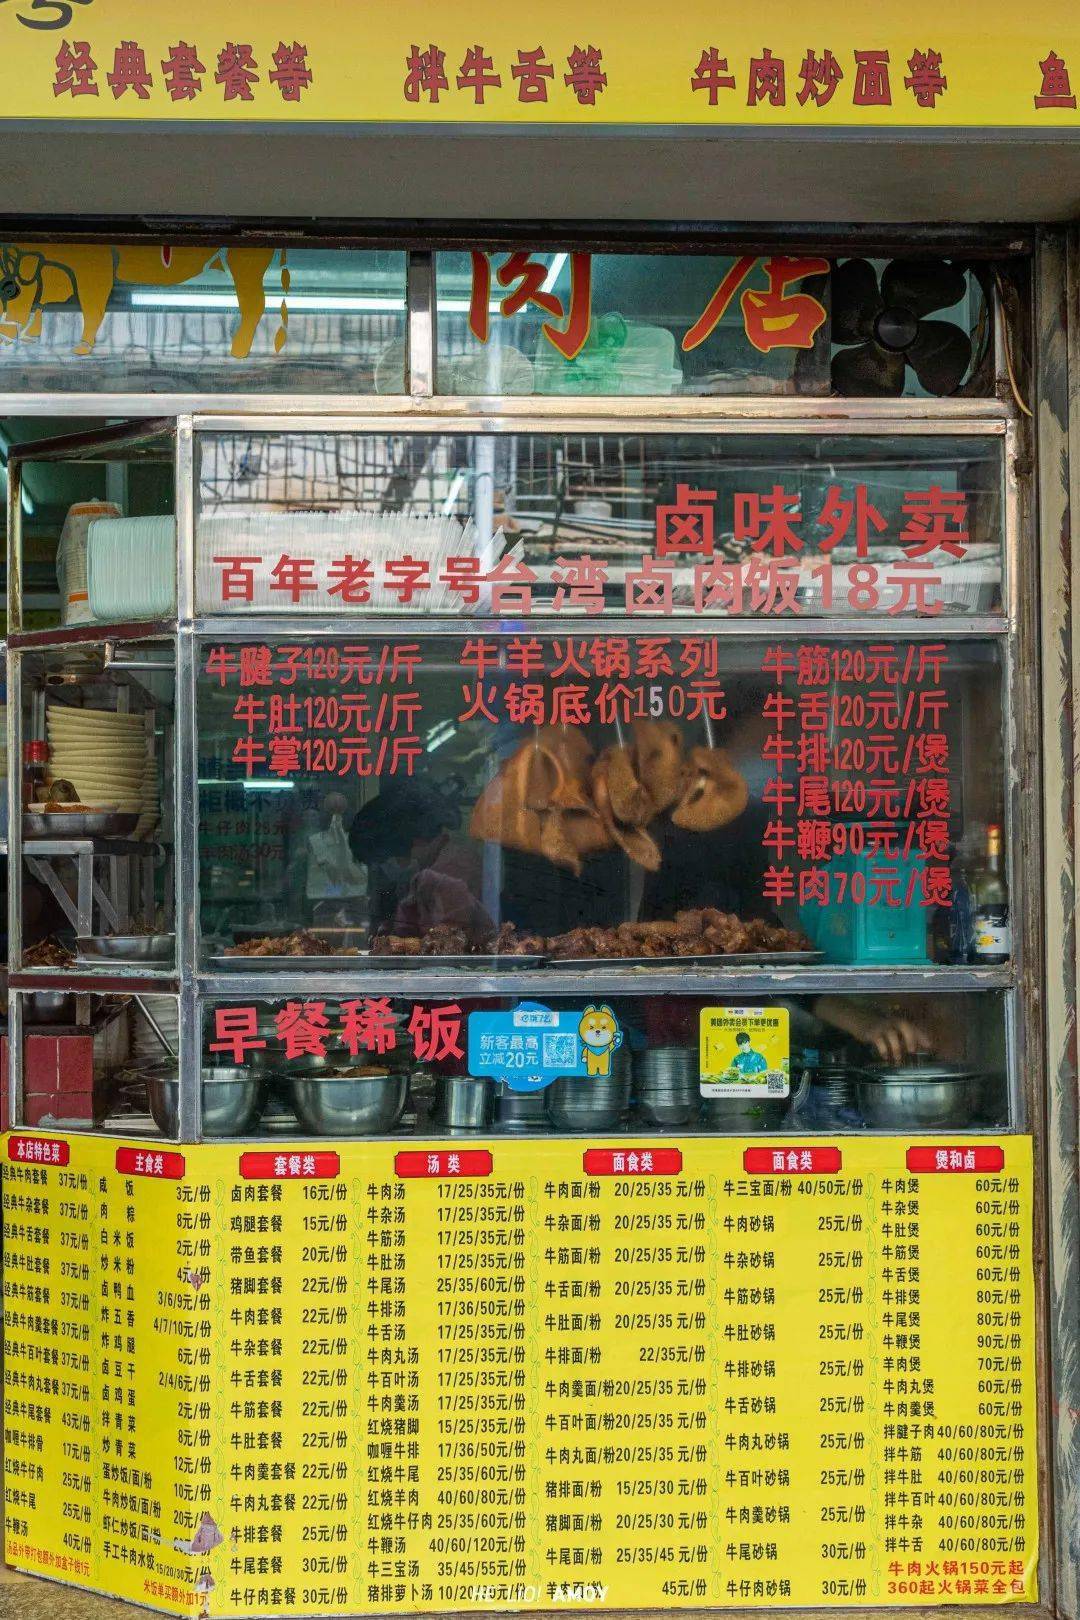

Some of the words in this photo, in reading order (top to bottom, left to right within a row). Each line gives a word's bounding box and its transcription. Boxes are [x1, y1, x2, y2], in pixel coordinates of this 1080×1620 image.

[53, 40, 314, 102] 经典套餐等
[403, 44, 608, 106] 拌牛舌等
[690, 48, 944, 108] 牛肉炒面等
[1034, 50, 1077, 109] 鱼
[656, 484, 969, 559] 卤味外卖
[213, 553, 487, 604] 百年老字号
[485, 555, 944, 615] 台湾卤肉饭18元
[460, 636, 719, 679] 牛羊火锅系列
[761, 644, 949, 686] 牛筋120元/斤
[458, 681, 727, 725] 火锅底价150元
[761, 689, 949, 731] 牛舌120元/斤
[233, 692, 422, 734] 牛肚120元/斤
[233, 736, 422, 777] 牛掌120元/斤
[761, 733, 950, 775] 牛排120元/煲
[762, 776, 952, 819] 牛尾120元/煲
[762, 820, 951, 863] 牛鞭90元/煲
[762, 865, 953, 908] 羊肉70元/煲
[209, 997, 465, 1064] 早餐稀饭
[479, 1034, 539, 1051] 新客最高
[479, 1051, 539, 1069] 立减20元
[17, 1139, 60, 1162] 本店特色菜
[935, 1149, 976, 1170] 煲和卤
[135, 1153, 164, 1175] 主食类
[274, 1155, 316, 1176] 套餐类
[612, 1152, 655, 1173] 面食类
[772, 1150, 813, 1171] 面食类
[176, 1186, 211, 1202] 3元/份
[231, 1185, 283, 1202] 卤肉套餐
[303, 1184, 348, 1200] 16元/份
[366, 1183, 406, 1200] 牛肉汤
[437, 1182, 525, 1199] 17/25/35元/份
[544, 1181, 601, 1198] 牛肉面/粉
[723, 1179, 793, 1196] 牛三宝面/粉
[797, 1179, 864, 1195] 40/50元/份
[881, 1179, 919, 1193] 牛肉煲
[975, 1178, 1020, 1192] 60元/份
[59, 1202, 89, 1221] 37元/份
[366, 1207, 406, 1223] 牛杂汤
[437, 1205, 525, 1222] 17/25/35元/份
[176, 1213, 211, 1229] 8元/份
[230, 1215, 283, 1232] 鸡腿套餐
[303, 1215, 348, 1231] 15元/份
[544, 1214, 601, 1231] 牛杂面/粉
[723, 1215, 775, 1232] 牛肉砂锅
[818, 1215, 863, 1231] 25元/份
[881, 1223, 919, 1237] 牛肚煲
[975, 1222, 1020, 1237] 60元/份
[60, 1232, 89, 1251] 37元/份
[176, 1240, 211, 1257] 2元/份
[230, 1246, 283, 1263] 带鱼套餐
[302, 1245, 348, 1262] 20元/份
[366, 1254, 406, 1270] 牛肚汤
[437, 1252, 526, 1269] 17/25/35元/份
[544, 1247, 601, 1264] 牛筋面/粉
[881, 1267, 920, 1282] 牛舌煲
[976, 1267, 1021, 1281] 60元/份
[230, 1277, 283, 1294] 猪脚套餐
[302, 1276, 348, 1293] 22元/份
[367, 1277, 406, 1294] 牛尾汤
[437, 1276, 526, 1293] 25/35/60元/份
[544, 1280, 601, 1297] 牛舌面/粉
[158, 1291, 211, 1311] 3/6/9元/份
[723, 1287, 775, 1305] 牛筋砂锅
[818, 1287, 864, 1303] 25元/份
[230, 1308, 283, 1325] 牛肉套餐
[302, 1307, 348, 1324] 22元/份
[544, 1313, 602, 1331] 牛肚面/粉
[882, 1312, 920, 1327] 牛尾煲
[977, 1311, 1022, 1326] 80元/份
[153, 1318, 211, 1338] 4/7/10元/份
[367, 1324, 406, 1341] 牛舌汤
[437, 1323, 526, 1340] 17/25/35元/份
[230, 1338, 283, 1356] 牛杂套餐
[302, 1338, 348, 1355] 22元/份
[544, 1347, 602, 1364] 牛排面/粉
[639, 1345, 706, 1362] 22/35元/份
[62, 1352, 90, 1371] 37元/份
[177, 1348, 211, 1365] 6元/份
[882, 1357, 921, 1371] 羊肉煲
[977, 1356, 1022, 1371] 70元/份
[724, 1360, 776, 1377] 牛排砂锅
[819, 1360, 864, 1376] 25元/份
[159, 1371, 211, 1392] 2/4/6元/份
[367, 1371, 419, 1388] 牛百叶汤
[438, 1370, 526, 1387] 17/25/35元/份
[883, 1379, 934, 1394] 牛肉丸煲
[978, 1379, 1023, 1393] 60元/份
[61, 1381, 90, 1402] 37元/份
[177, 1402, 211, 1420] 2元/份
[230, 1401, 283, 1418] 牛筋套餐
[302, 1400, 348, 1417] 22元/份
[367, 1418, 419, 1435] 红烧猪脚
[438, 1417, 526, 1434] 15/25/35元/份
[5, 1428, 44, 1452] 咖喱牛排骨
[62, 1442, 90, 1463] 17元/份
[177, 1429, 211, 1447] 8元/份
[174, 1456, 211, 1474] 12元/份
[367, 1465, 420, 1482] 红烧牛尾
[437, 1464, 526, 1482] 25/35/60元/份
[4, 1457, 44, 1483] 红烧牛仔肉
[62, 1472, 91, 1493] 25元/份
[103, 1462, 152, 1490] 蛋炒饭/面/粉
[725, 1469, 790, 1487] 牛百叶砂锅
[820, 1469, 866, 1485] 25元/份
[884, 1469, 923, 1484] 拌牛肚
[938, 1469, 1025, 1484] 40/60/80元/份
[174, 1483, 211, 1502] 10元/份
[367, 1489, 419, 1506] 红烧羊肉
[437, 1488, 527, 1505] 40/60/80元/份
[5, 1486, 37, 1510] 红烧牛尾
[62, 1502, 91, 1523] 25元/份
[103, 1489, 161, 1519] 牛肉炒饭/面/粉
[367, 1512, 432, 1530] 红烧牛仔肉
[437, 1512, 527, 1529] 25/35/60元/份
[884, 1514, 923, 1529] 拌牛杂
[939, 1514, 1026, 1529] 40/60/80元/份
[5, 1517, 28, 1538] 牛鞭汤
[63, 1534, 91, 1554] 40元/份
[231, 1525, 283, 1543] 牛排套餐
[302, 1525, 348, 1541] 25元/份
[885, 1537, 923, 1552] 拌牛舌
[939, 1537, 1026, 1551] 40/60/80元/份
[103, 1540, 155, 1571] 手工牛肉水饺
[545, 1547, 603, 1565] 牛尾面/粉
[230, 1556, 283, 1574] 牛尾套餐
[302, 1556, 348, 1573] 30元/份
[367, 1560, 420, 1578] 牛三宝汤
[437, 1559, 527, 1577] 35/45/55元/份
[887, 1560, 1024, 1576] 牛肉火锅150元起
[230, 1588, 296, 1605] 牛仔肉套餐
[302, 1587, 348, 1604] 30元/份
[661, 1579, 707, 1596] 45元/份
[726, 1580, 791, 1597] 牛仔肉砂锅
[822, 1579, 866, 1595] 30元/份
[887, 1579, 1025, 1596] 360起火锅菜全包
